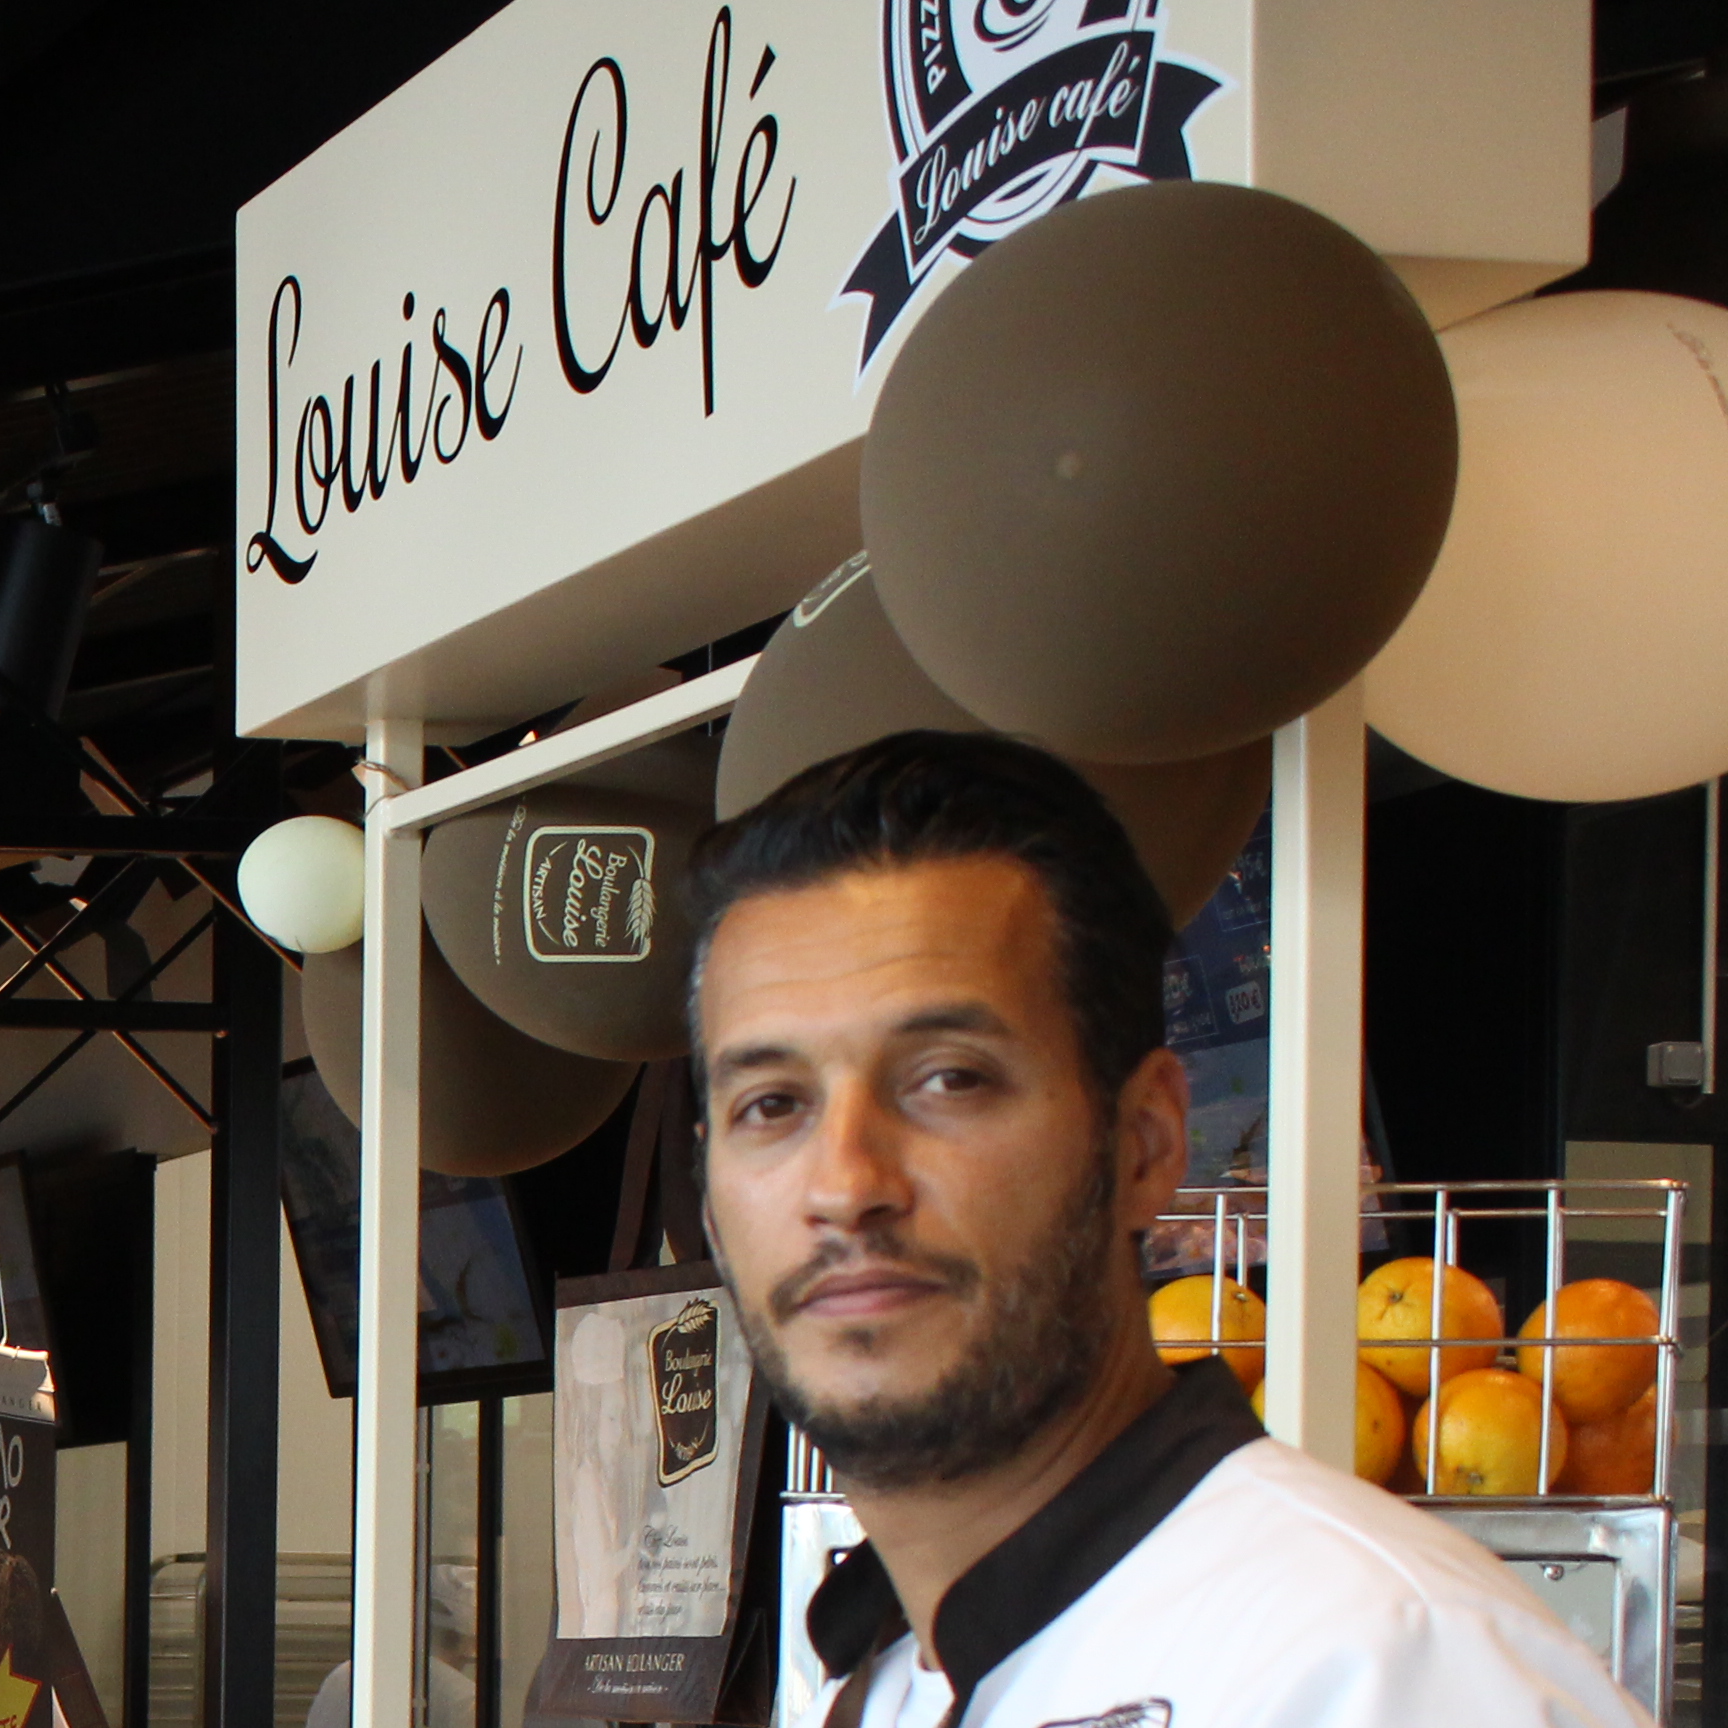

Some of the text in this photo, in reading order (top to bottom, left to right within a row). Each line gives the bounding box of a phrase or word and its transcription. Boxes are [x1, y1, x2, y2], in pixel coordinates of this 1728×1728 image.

[913, 40, 1142, 246] Louise café
[245, 4, 797, 584] Louise Café
[531, 857, 553, 920] ARTISAN
[562, 838, 604, 949] Louise
[590, 852, 628, 948] Boulangerie
